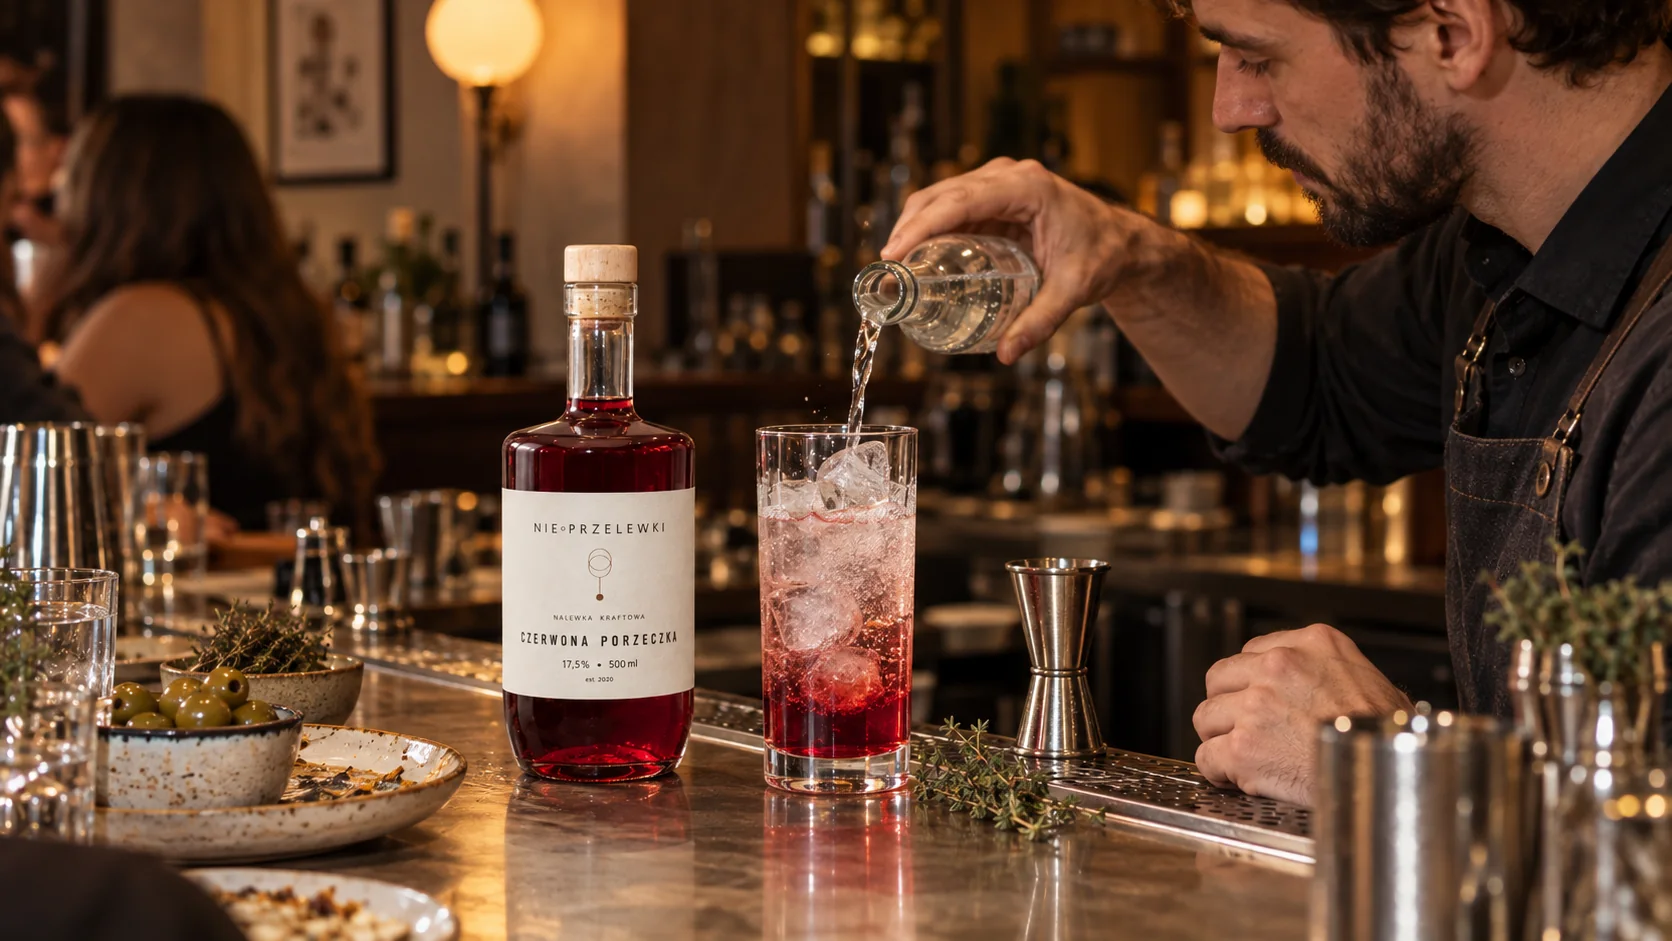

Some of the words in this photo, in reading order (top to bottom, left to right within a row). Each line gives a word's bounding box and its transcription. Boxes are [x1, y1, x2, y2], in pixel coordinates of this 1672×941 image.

[552, 614, 593, 622] NALEWKA
[599, 613, 646, 622] KRAFTOWA
[520, 631, 589, 647] CZERWONA
[600, 630, 678, 648] PORZECZKA
[562, 659, 590, 671] 17,5%
